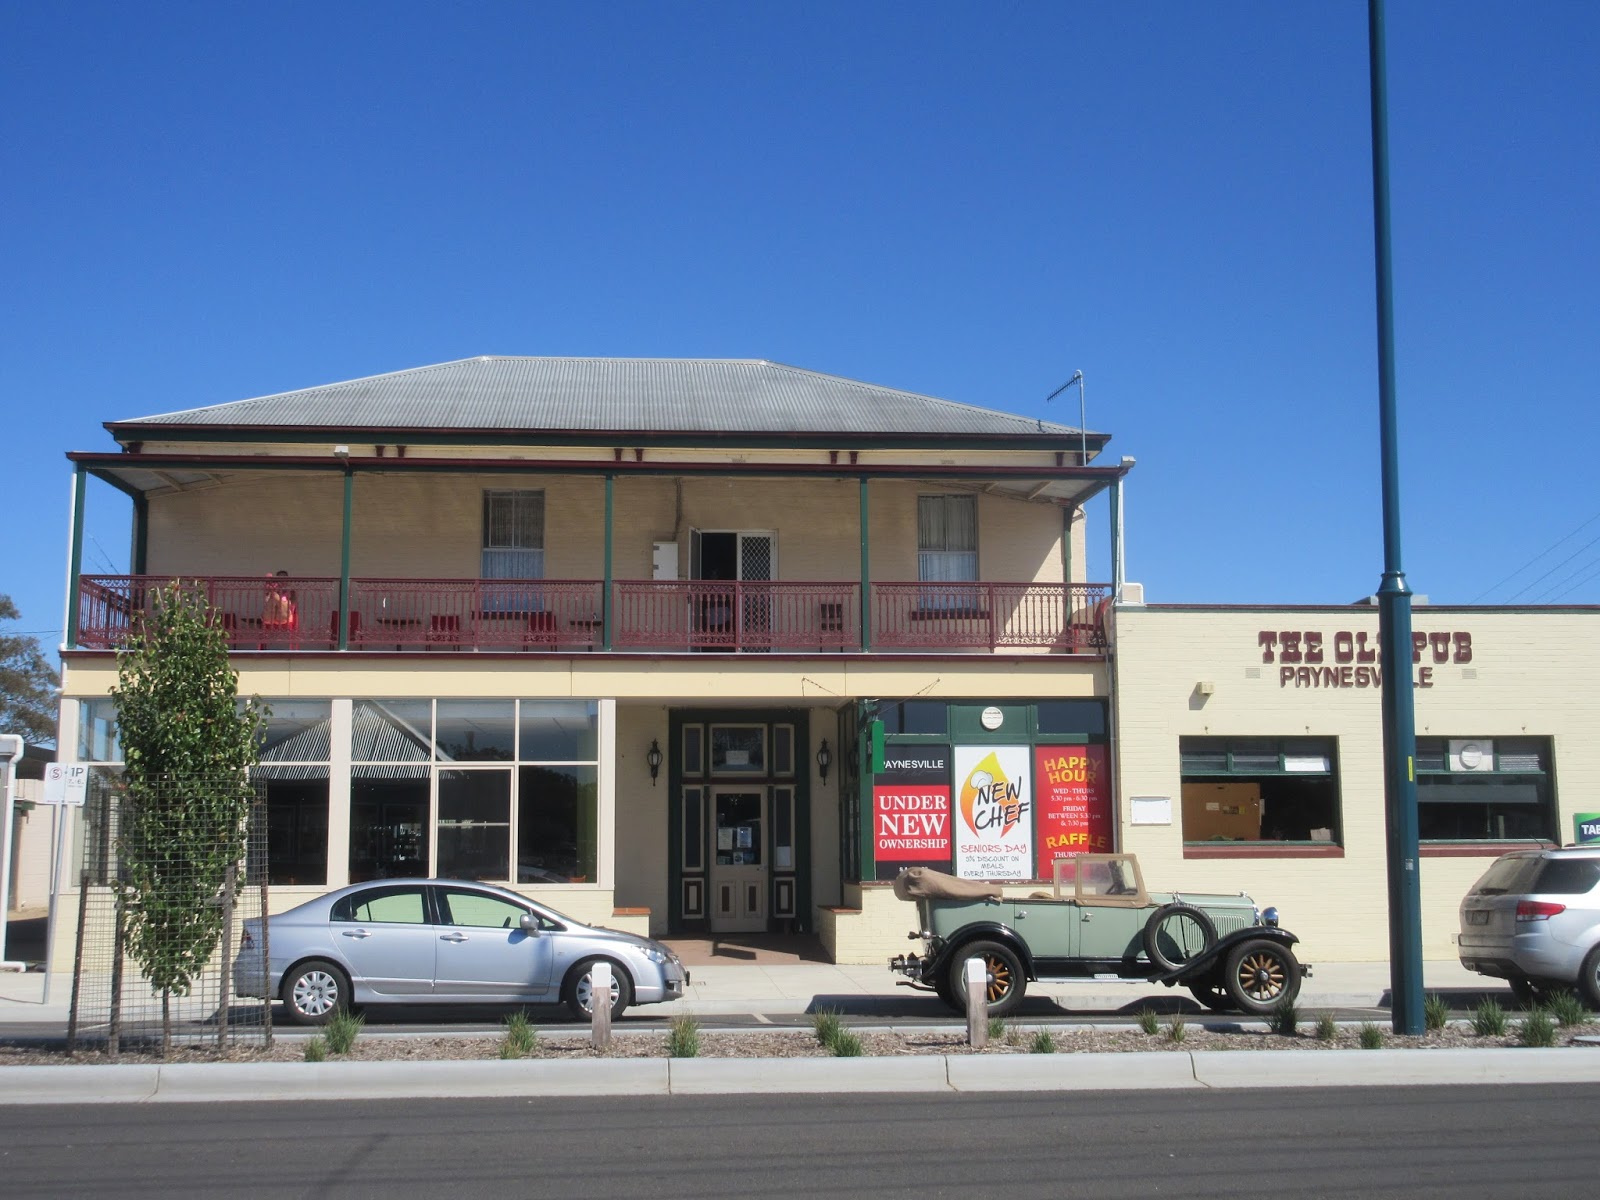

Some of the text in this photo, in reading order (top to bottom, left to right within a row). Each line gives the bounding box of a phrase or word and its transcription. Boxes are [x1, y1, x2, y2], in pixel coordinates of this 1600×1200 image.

[1258, 631, 1323, 664] THE
[1334, 631, 1381, 664] OL
[71, 767, 84, 777] 1P
[883, 760, 944, 769] AYNESVILLE
[1044, 756, 1101, 772] HAPPY
[1048, 769, 1097, 785] HOUR
[978, 775, 1022, 806] NEW
[879, 795, 947, 811] UNDER
[975, 802, 1030, 830] CHEF
[879, 813, 948, 836] NEW
[879, 838, 948, 849] OWNERSHIP
[960, 843, 1027, 855] SENIORS DAY
[1045, 833, 1107, 849] RAFFLE
[963, 870, 1022, 878] EVERY THURSDAY
